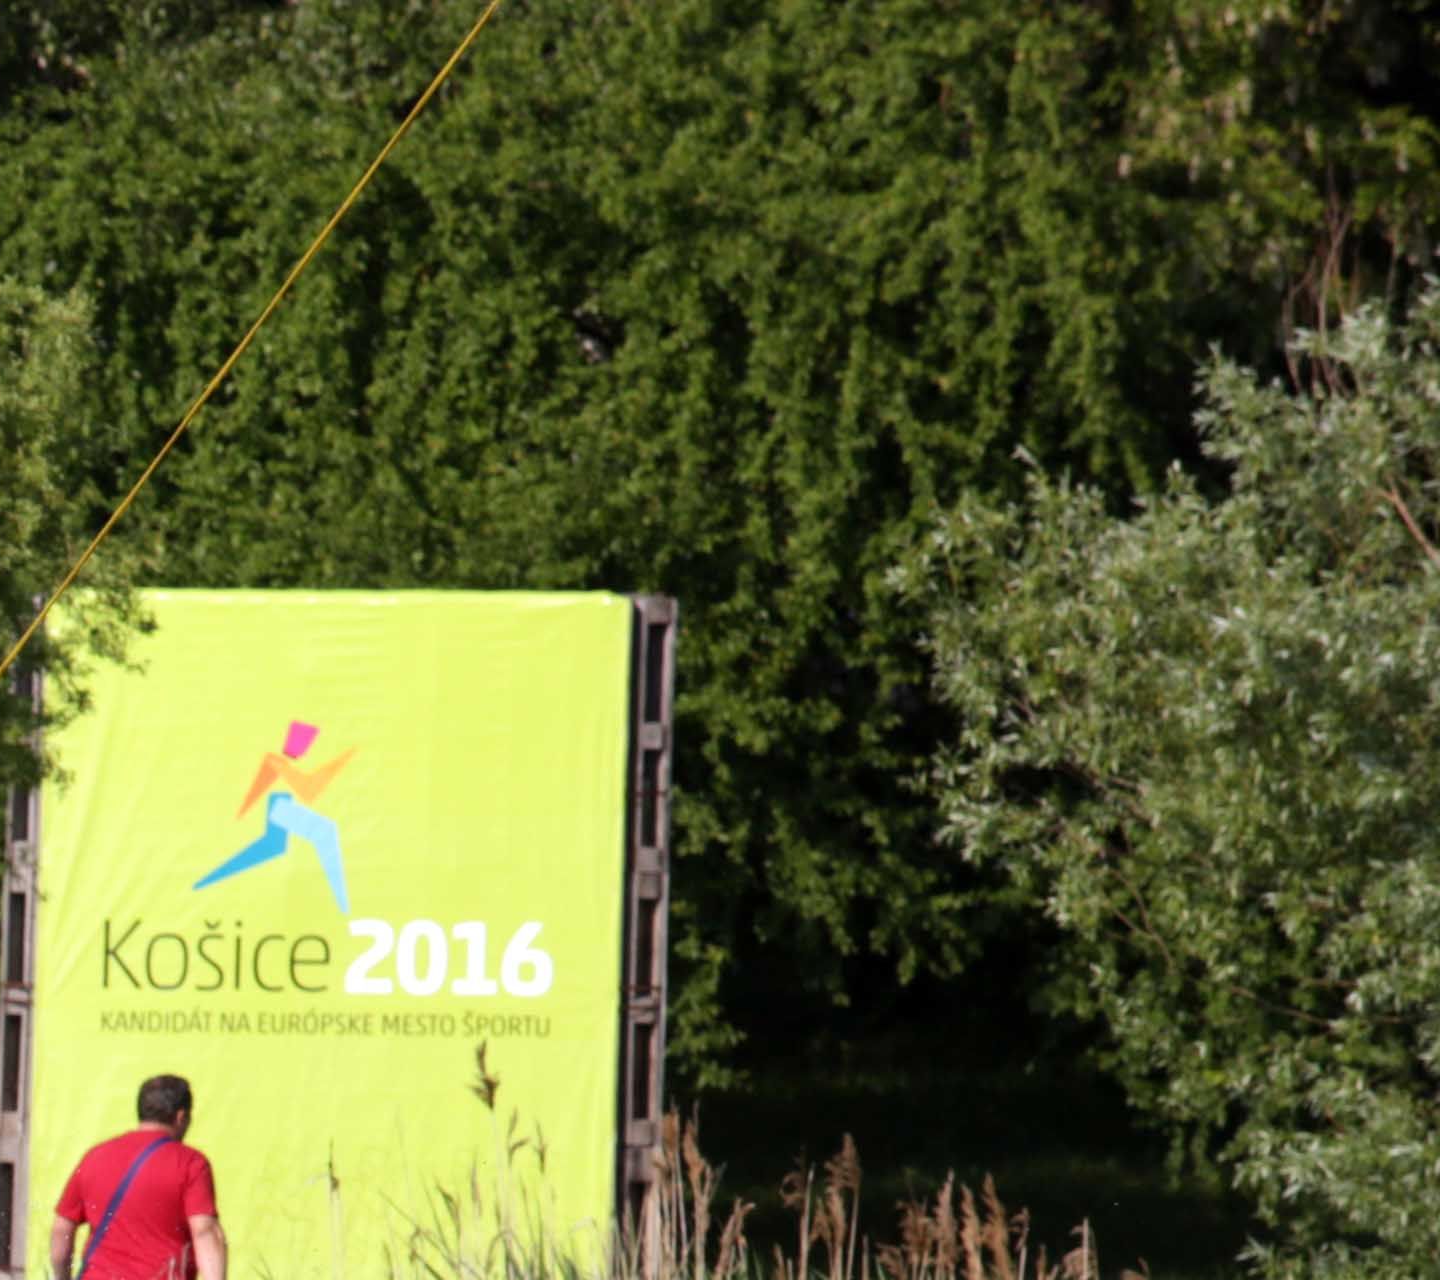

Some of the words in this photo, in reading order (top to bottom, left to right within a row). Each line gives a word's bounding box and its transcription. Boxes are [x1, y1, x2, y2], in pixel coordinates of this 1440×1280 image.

[101, 919, 331, 993] Košice
[343, 918, 554, 997] 2016
[100, 1006, 212, 1034] KANDIDÁT
[220, 1012, 252, 1034] NA
[258, 1007, 374, 1036] EURÓPSKE
[382, 1013, 456, 1036] MESTO
[463, 1009, 551, 1038] ŠPORTU
